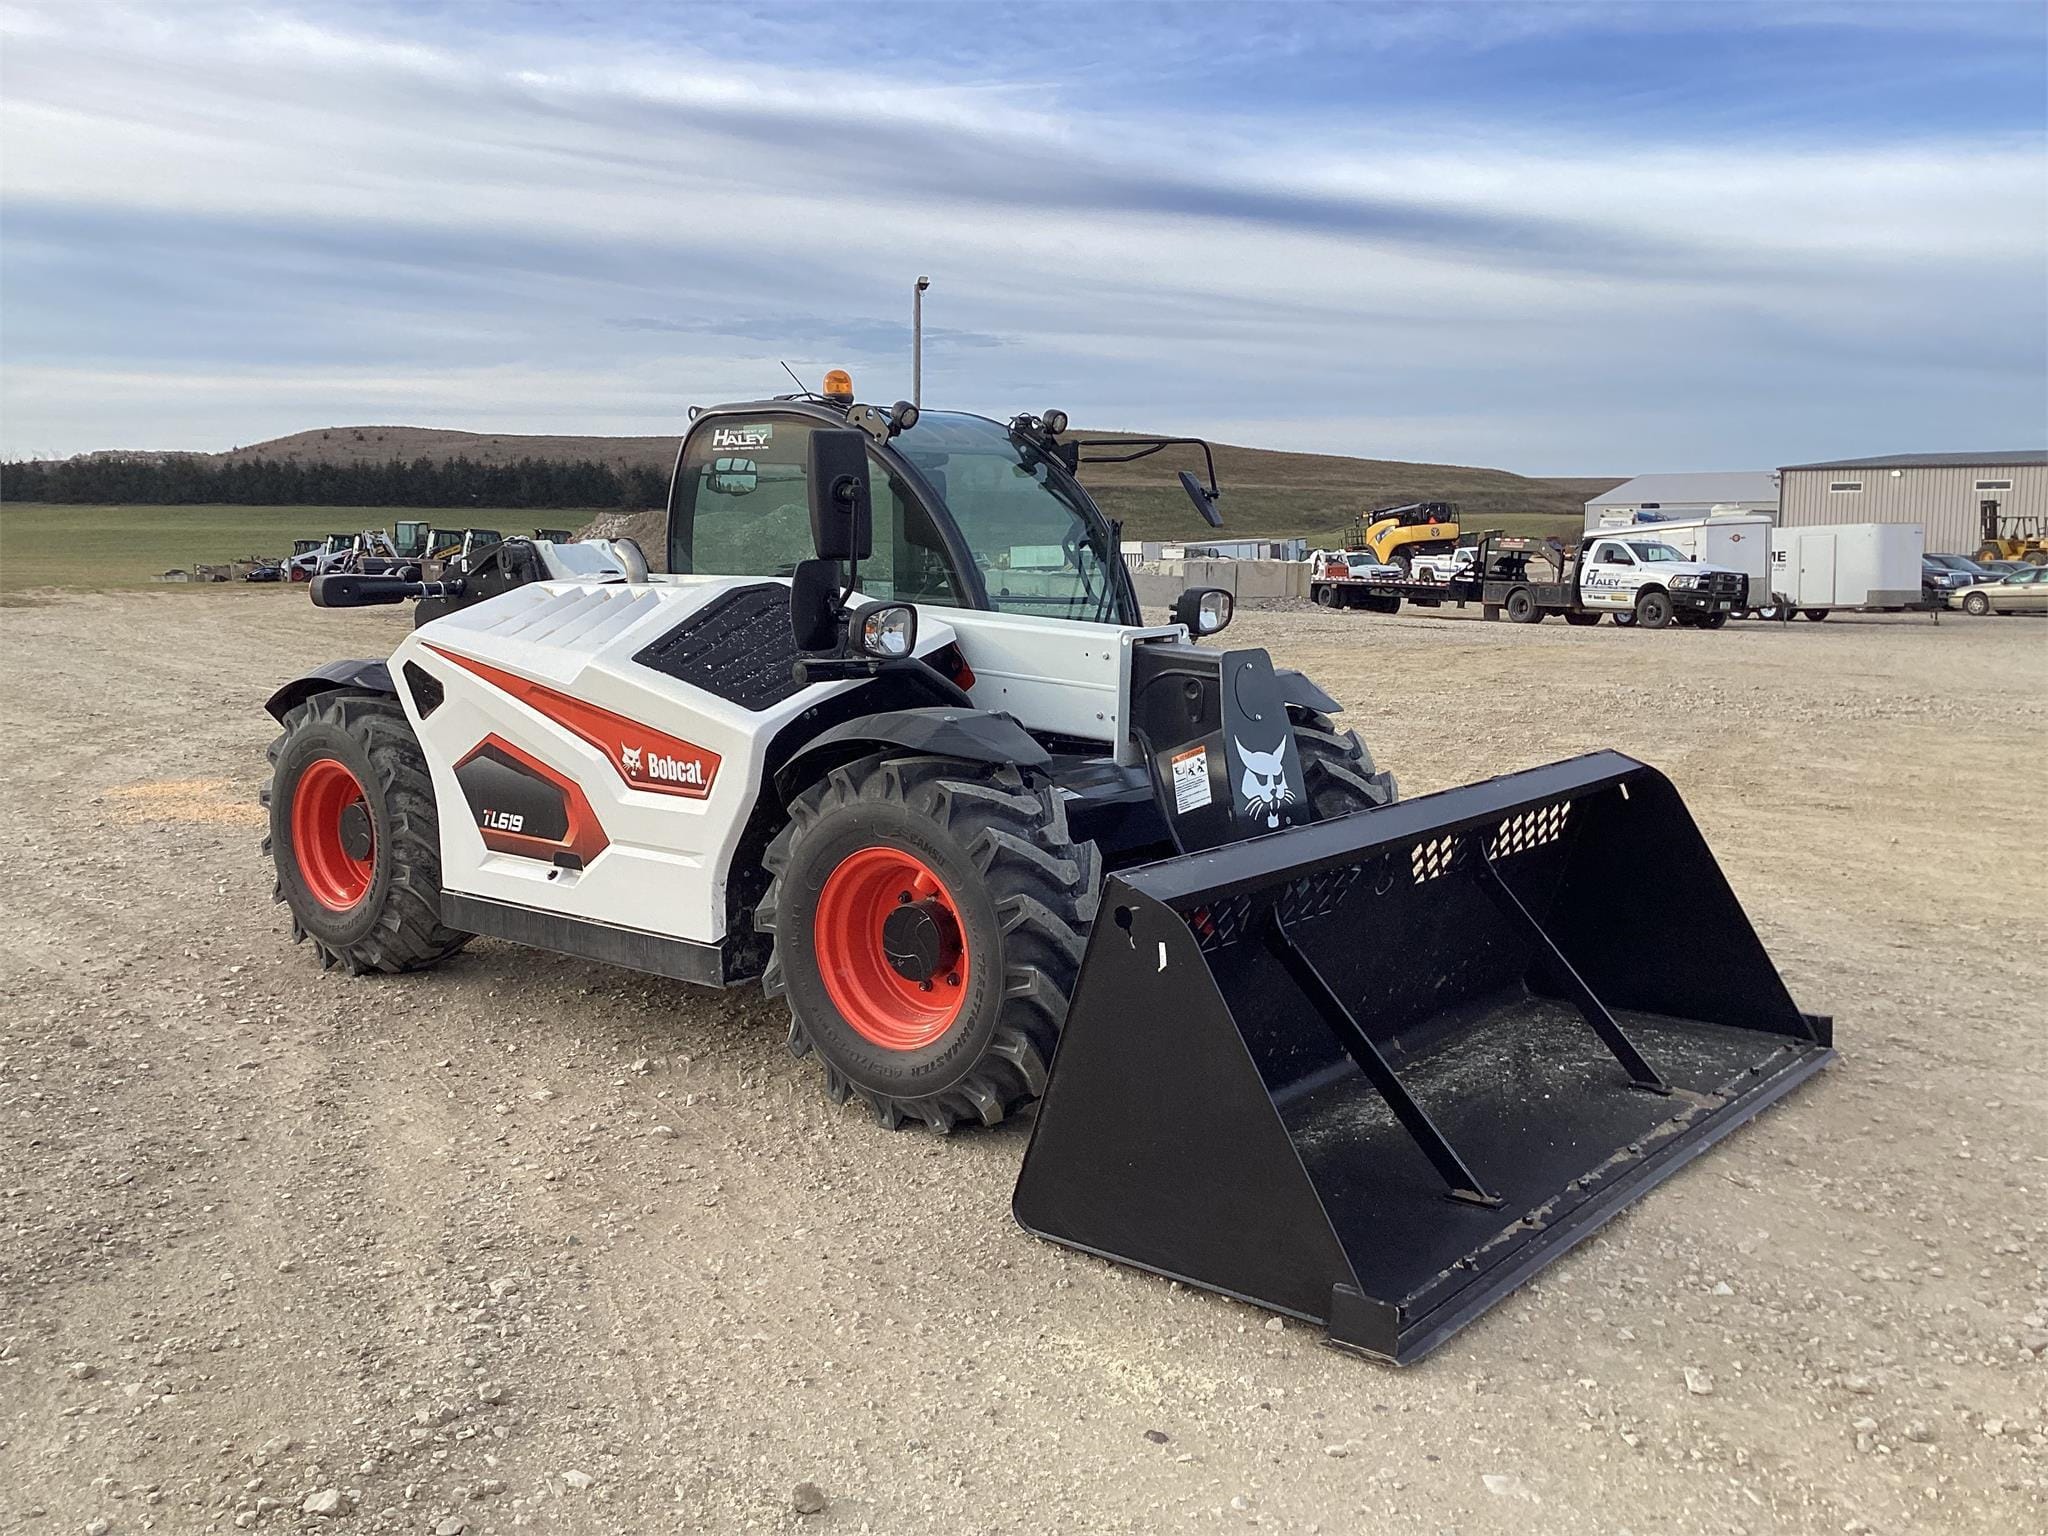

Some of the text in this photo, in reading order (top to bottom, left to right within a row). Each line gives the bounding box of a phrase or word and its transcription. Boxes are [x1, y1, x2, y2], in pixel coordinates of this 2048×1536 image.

[712, 429, 768, 446] HALEY
[1585, 572, 1620, 586] HALEY
[647, 752, 703, 785] Bobcat
[483, 809, 524, 832] TL619
